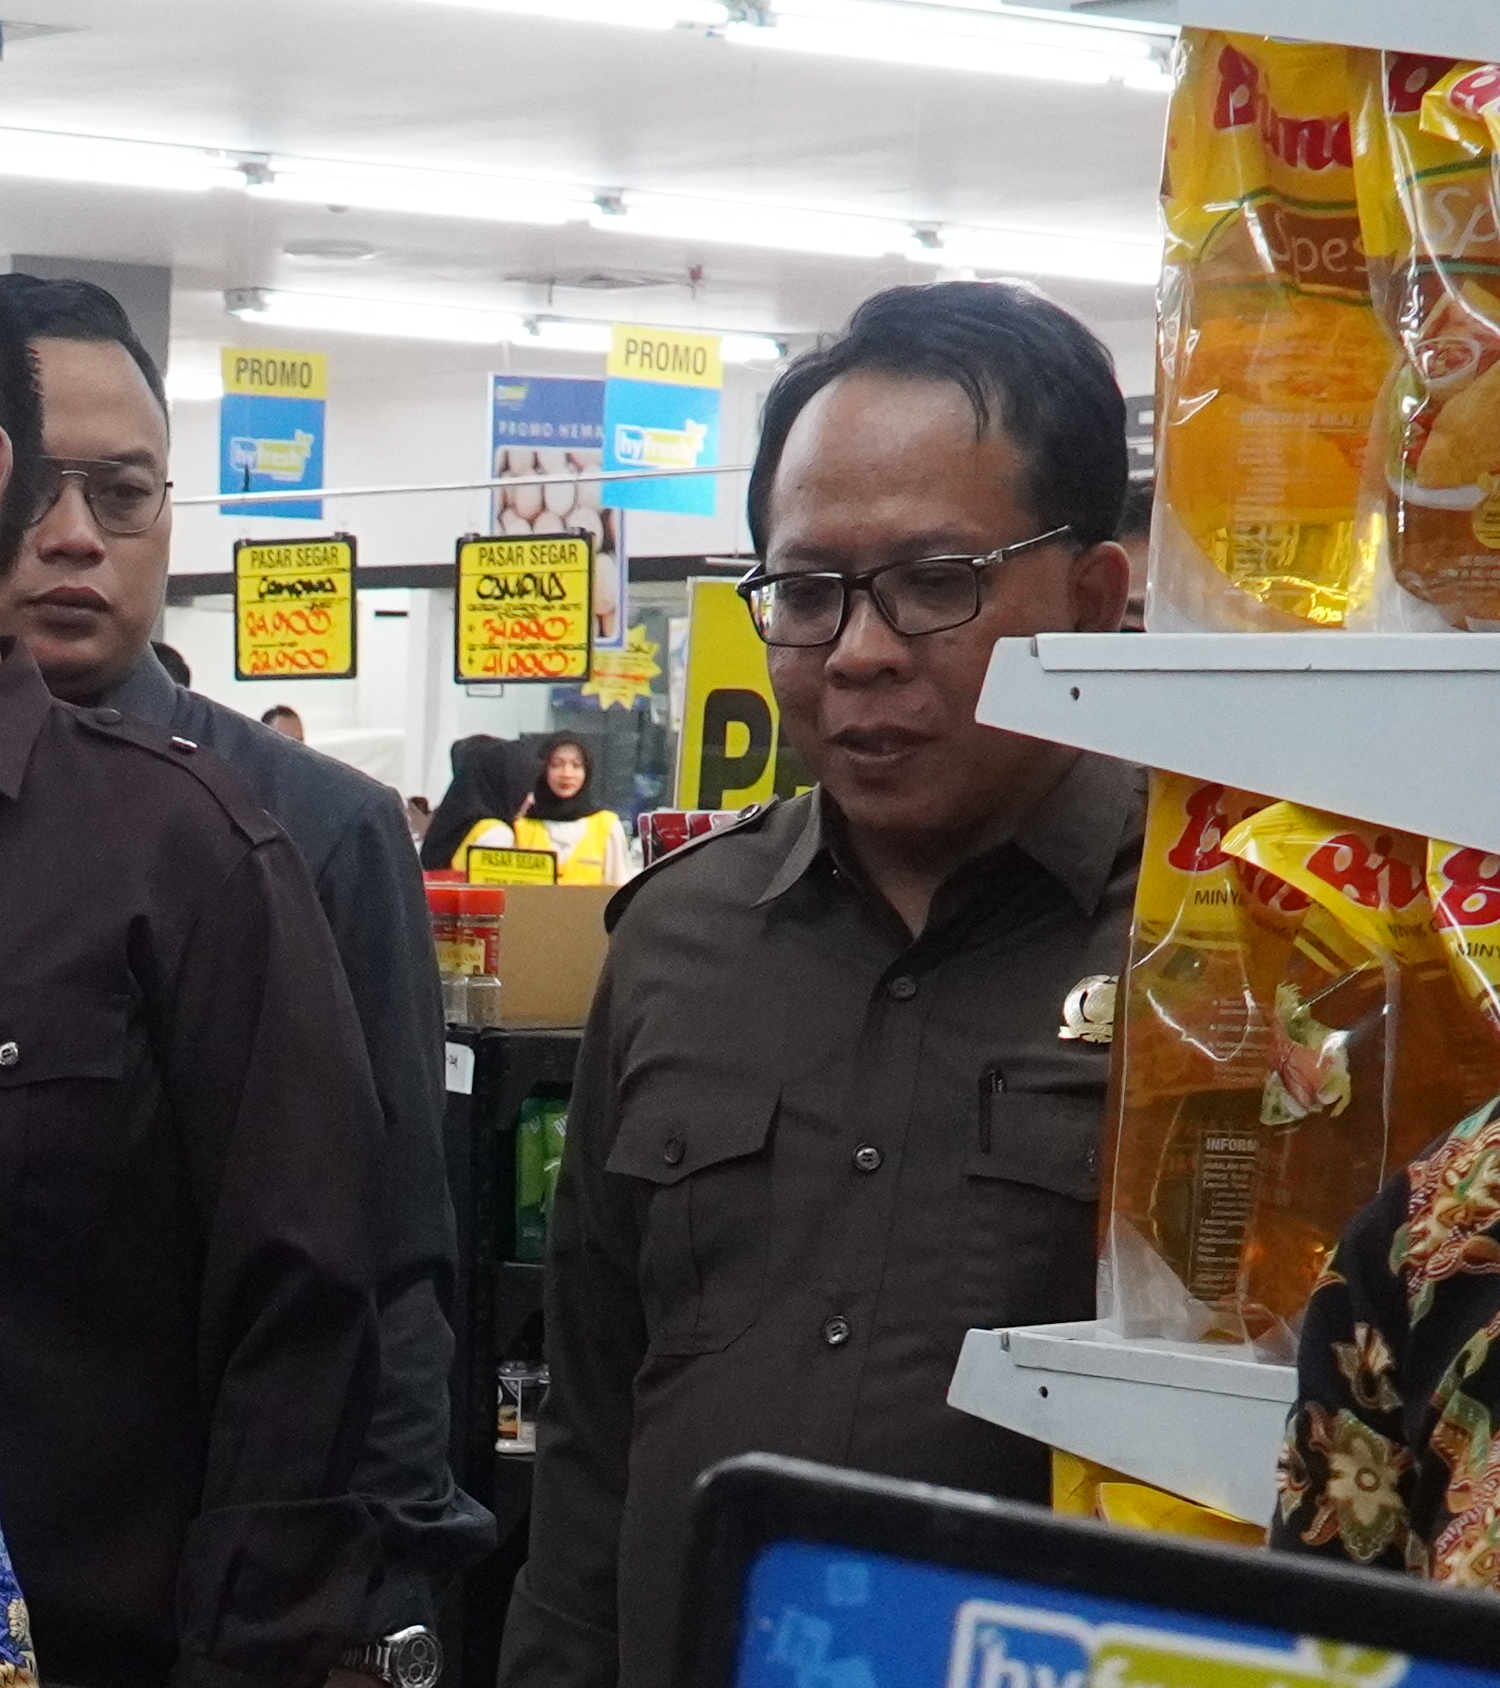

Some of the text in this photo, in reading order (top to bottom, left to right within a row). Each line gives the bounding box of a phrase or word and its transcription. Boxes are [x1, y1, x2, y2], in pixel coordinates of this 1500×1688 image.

[626, 338, 708, 376] PROMO
[235, 356, 313, 389] PROMO
[250, 545, 339, 570] PASAR SEGAR
[479, 544, 580, 568] PASAR SEGAR
